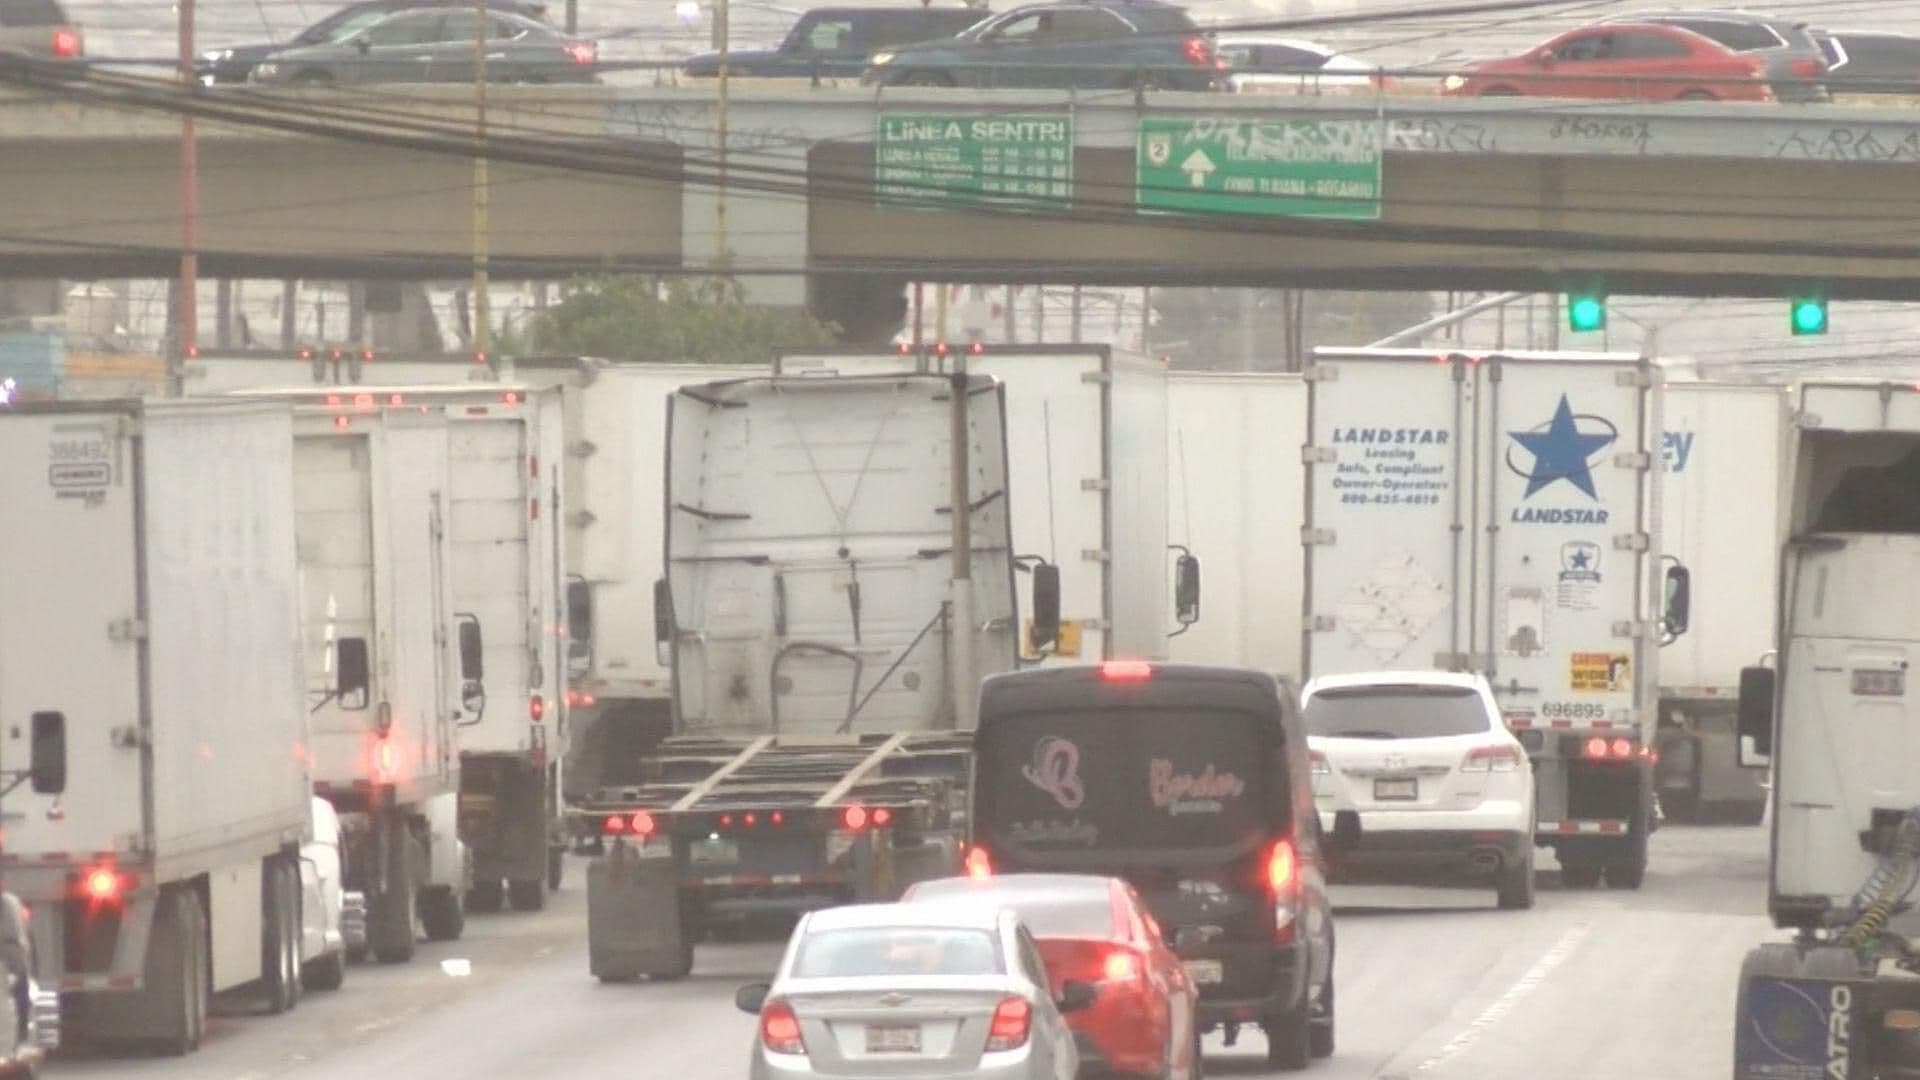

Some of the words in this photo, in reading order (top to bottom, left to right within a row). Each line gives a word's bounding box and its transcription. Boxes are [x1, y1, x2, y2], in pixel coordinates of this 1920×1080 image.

[970, 120, 1065, 142] SENTRI
[1333, 428, 1449, 444] LANDSTAR
[1365, 447, 1415, 461] Leasing
[1337, 463, 1370, 475] Safe,
[1375, 463, 1444, 477] Compliant
[1332, 477, 1449, 491] Owner-Operators
[1511, 507, 1609, 524] LANDSTAR
[1542, 702, 1606, 719] 696895
